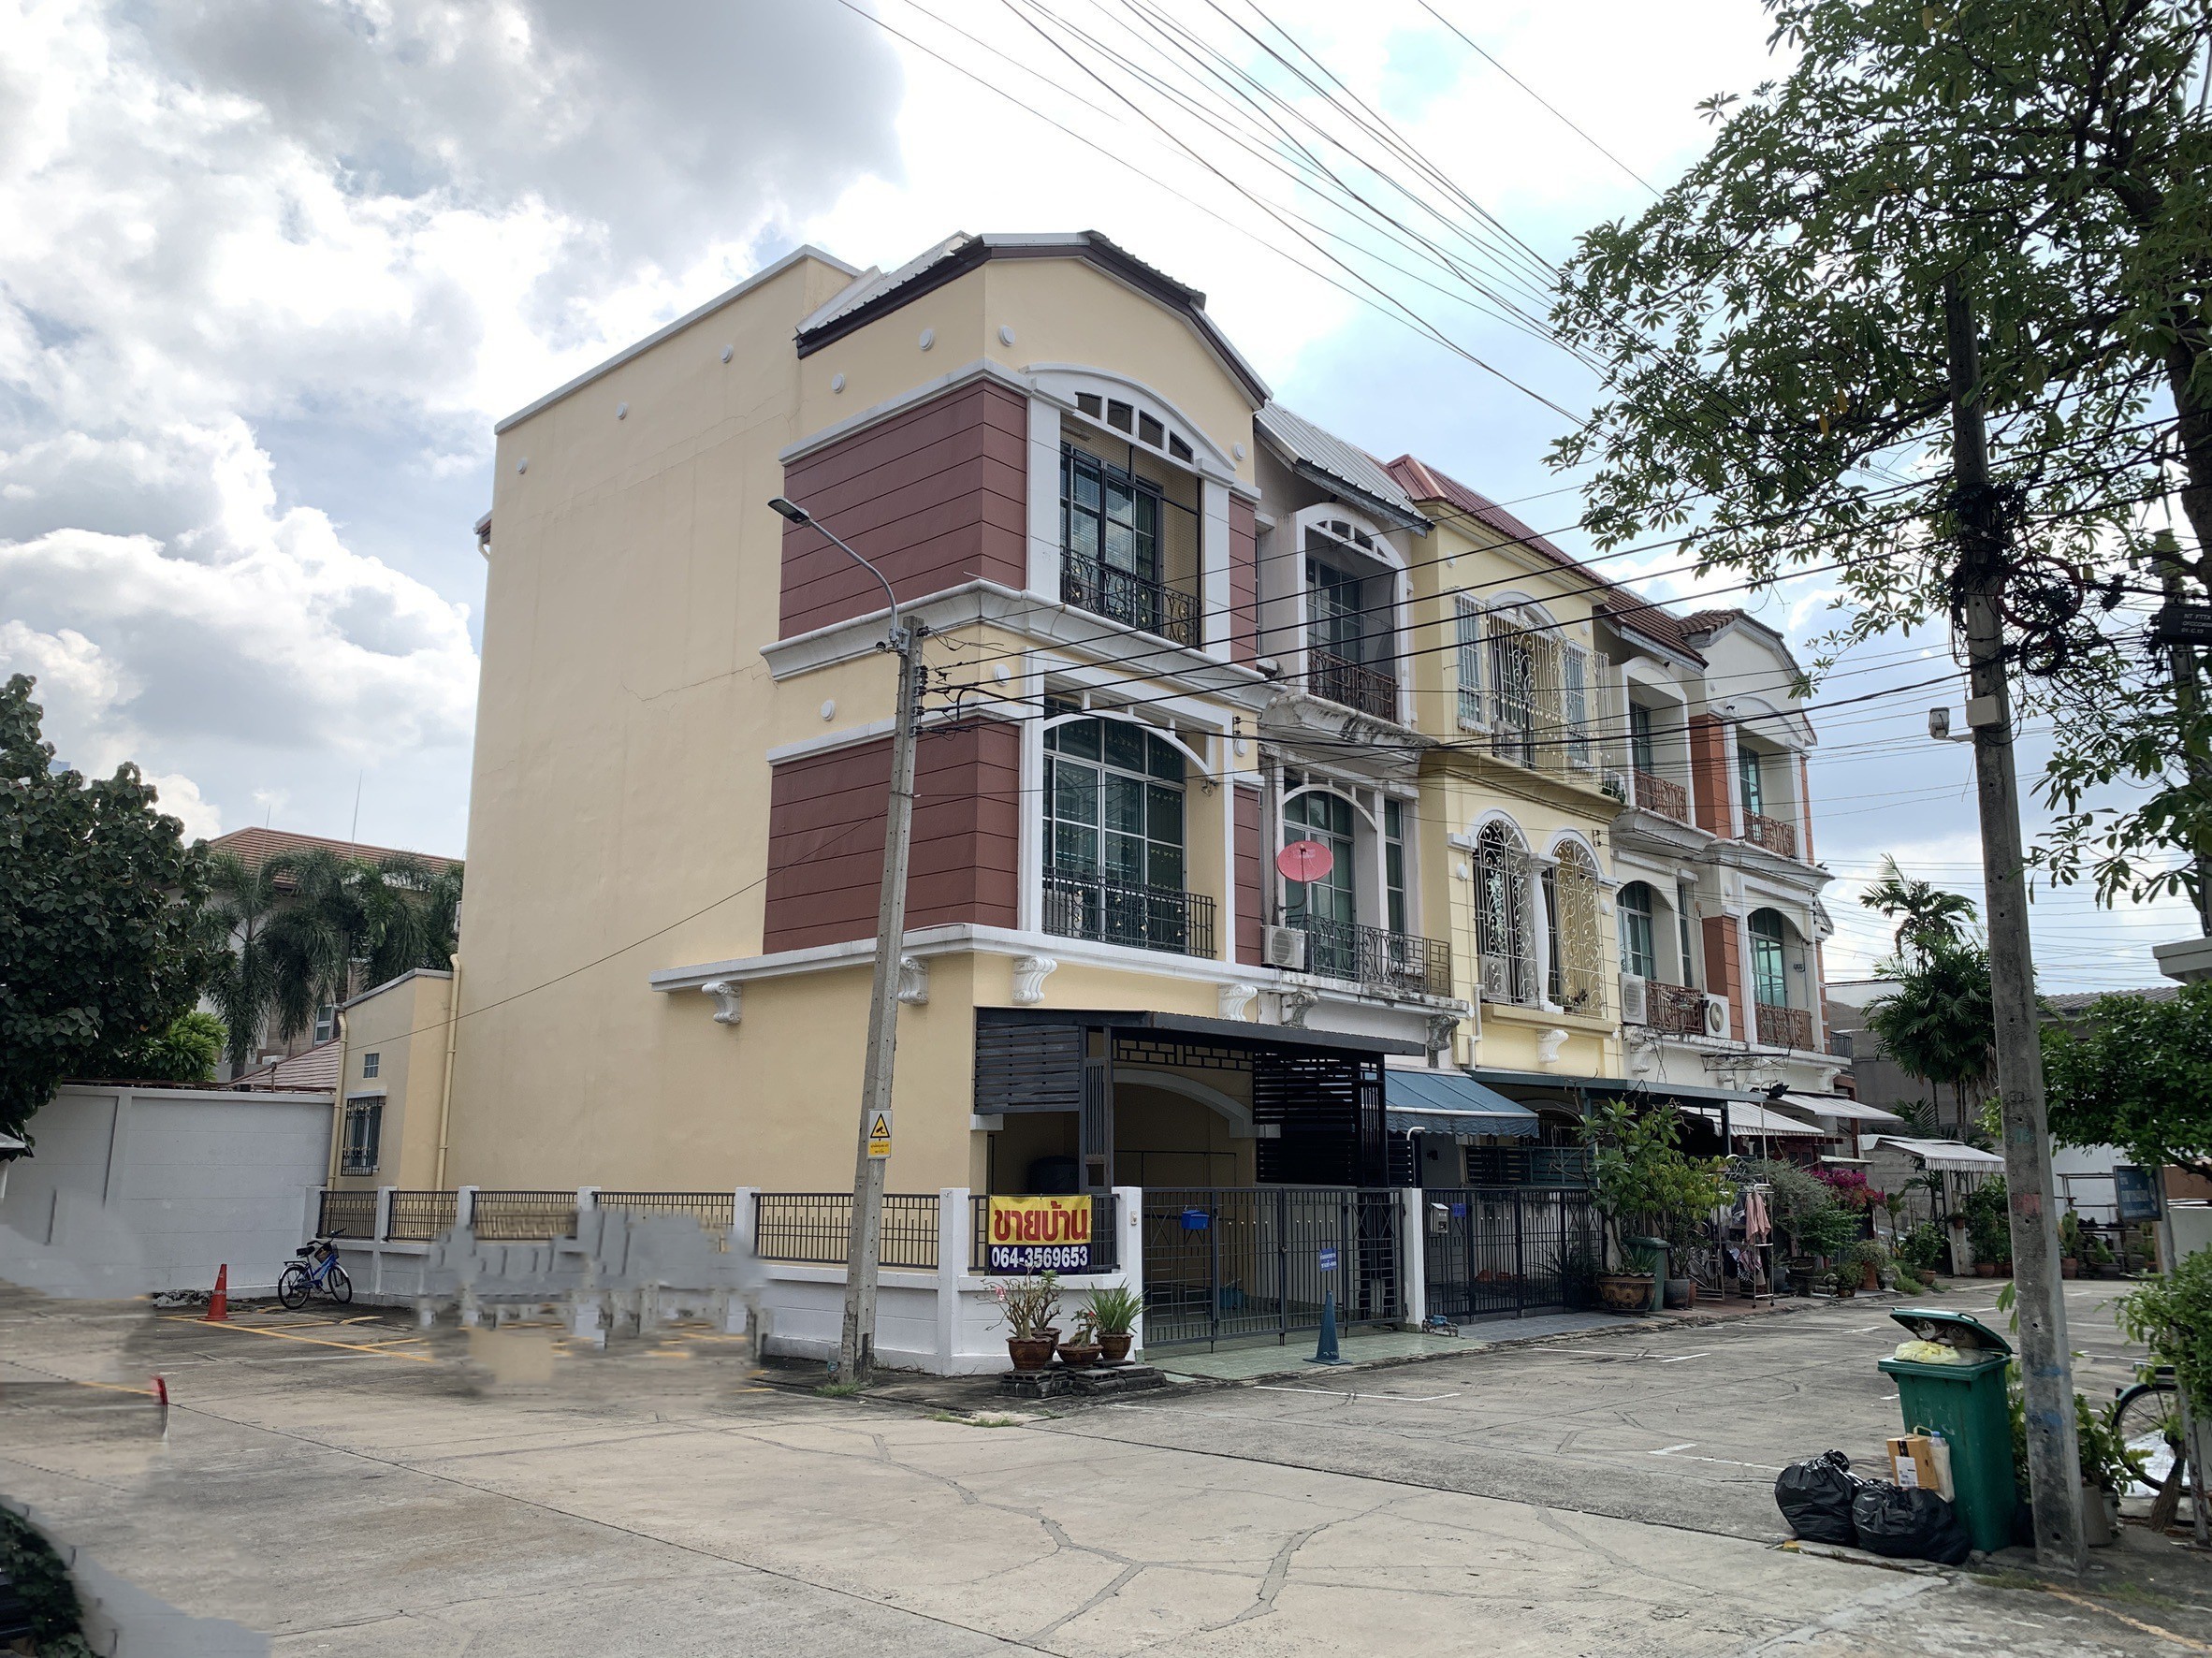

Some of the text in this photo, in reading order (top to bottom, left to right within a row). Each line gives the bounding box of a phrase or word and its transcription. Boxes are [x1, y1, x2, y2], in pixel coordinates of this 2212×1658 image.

[994, 1200, 1087, 1242] ขายบ้าน
[991, 1245, 1088, 1268] 064-3569653
